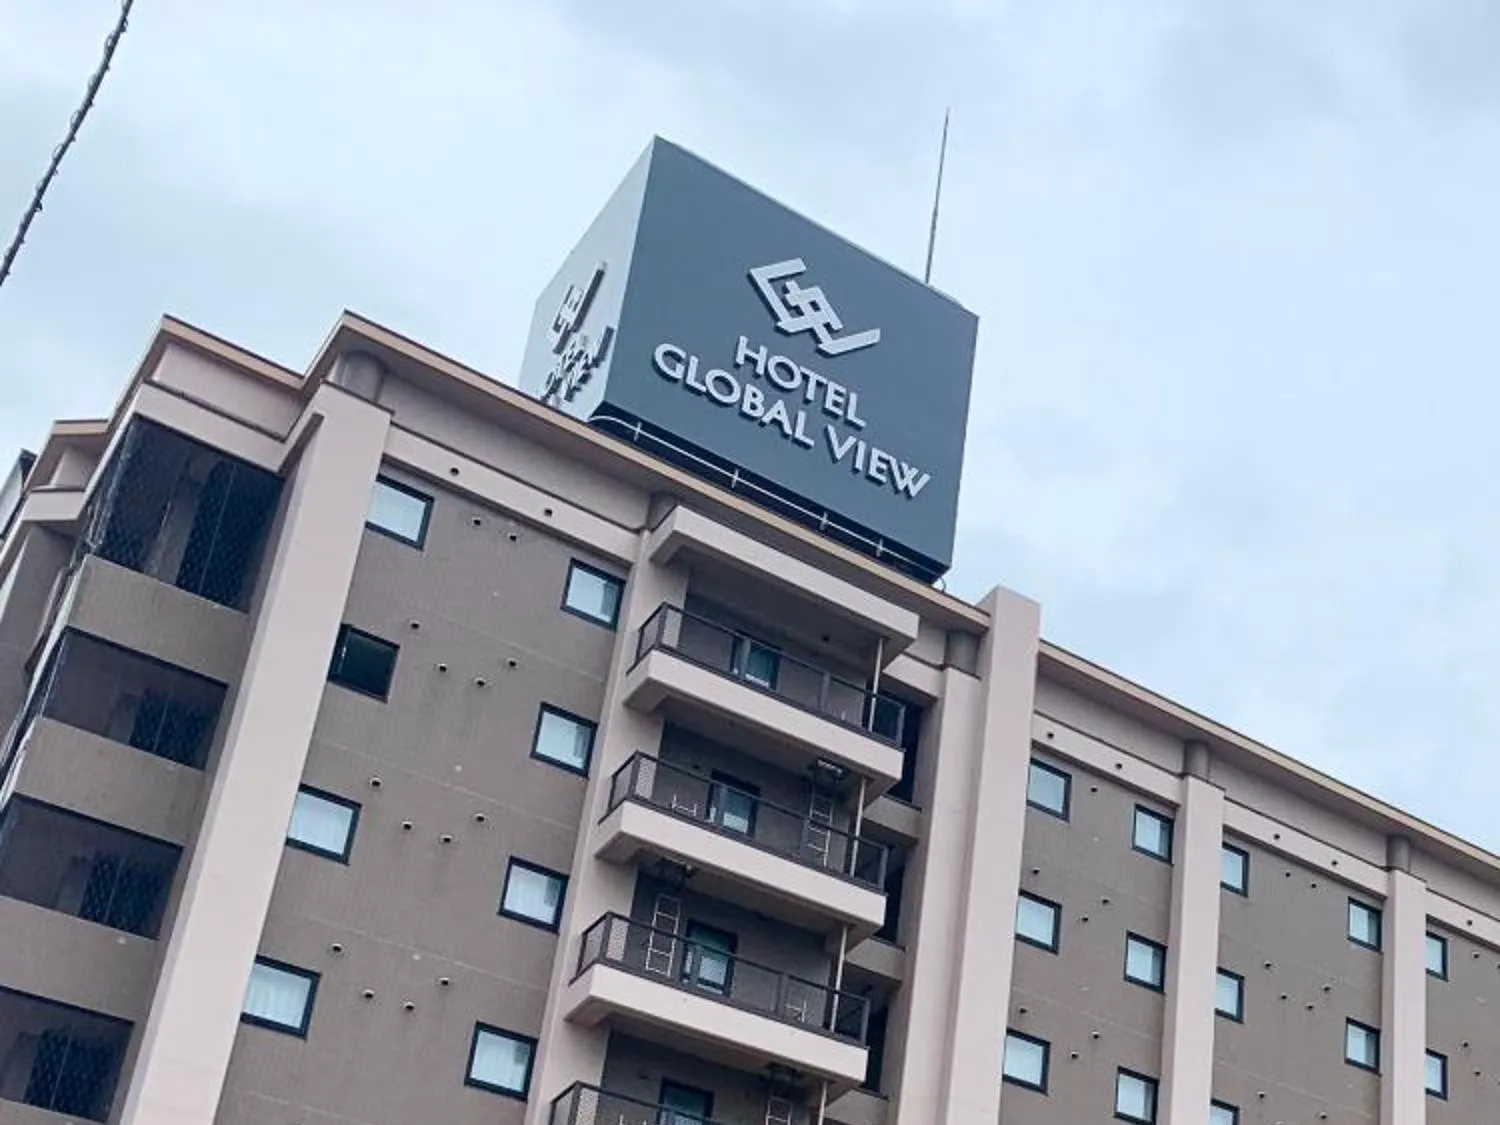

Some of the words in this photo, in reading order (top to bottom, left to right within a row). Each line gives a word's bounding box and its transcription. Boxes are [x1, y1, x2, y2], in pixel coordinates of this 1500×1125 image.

[652, 342, 815, 449] GLOBAL
[826, 423, 931, 499] VIEW
[735, 335, 867, 428] HOTEL
